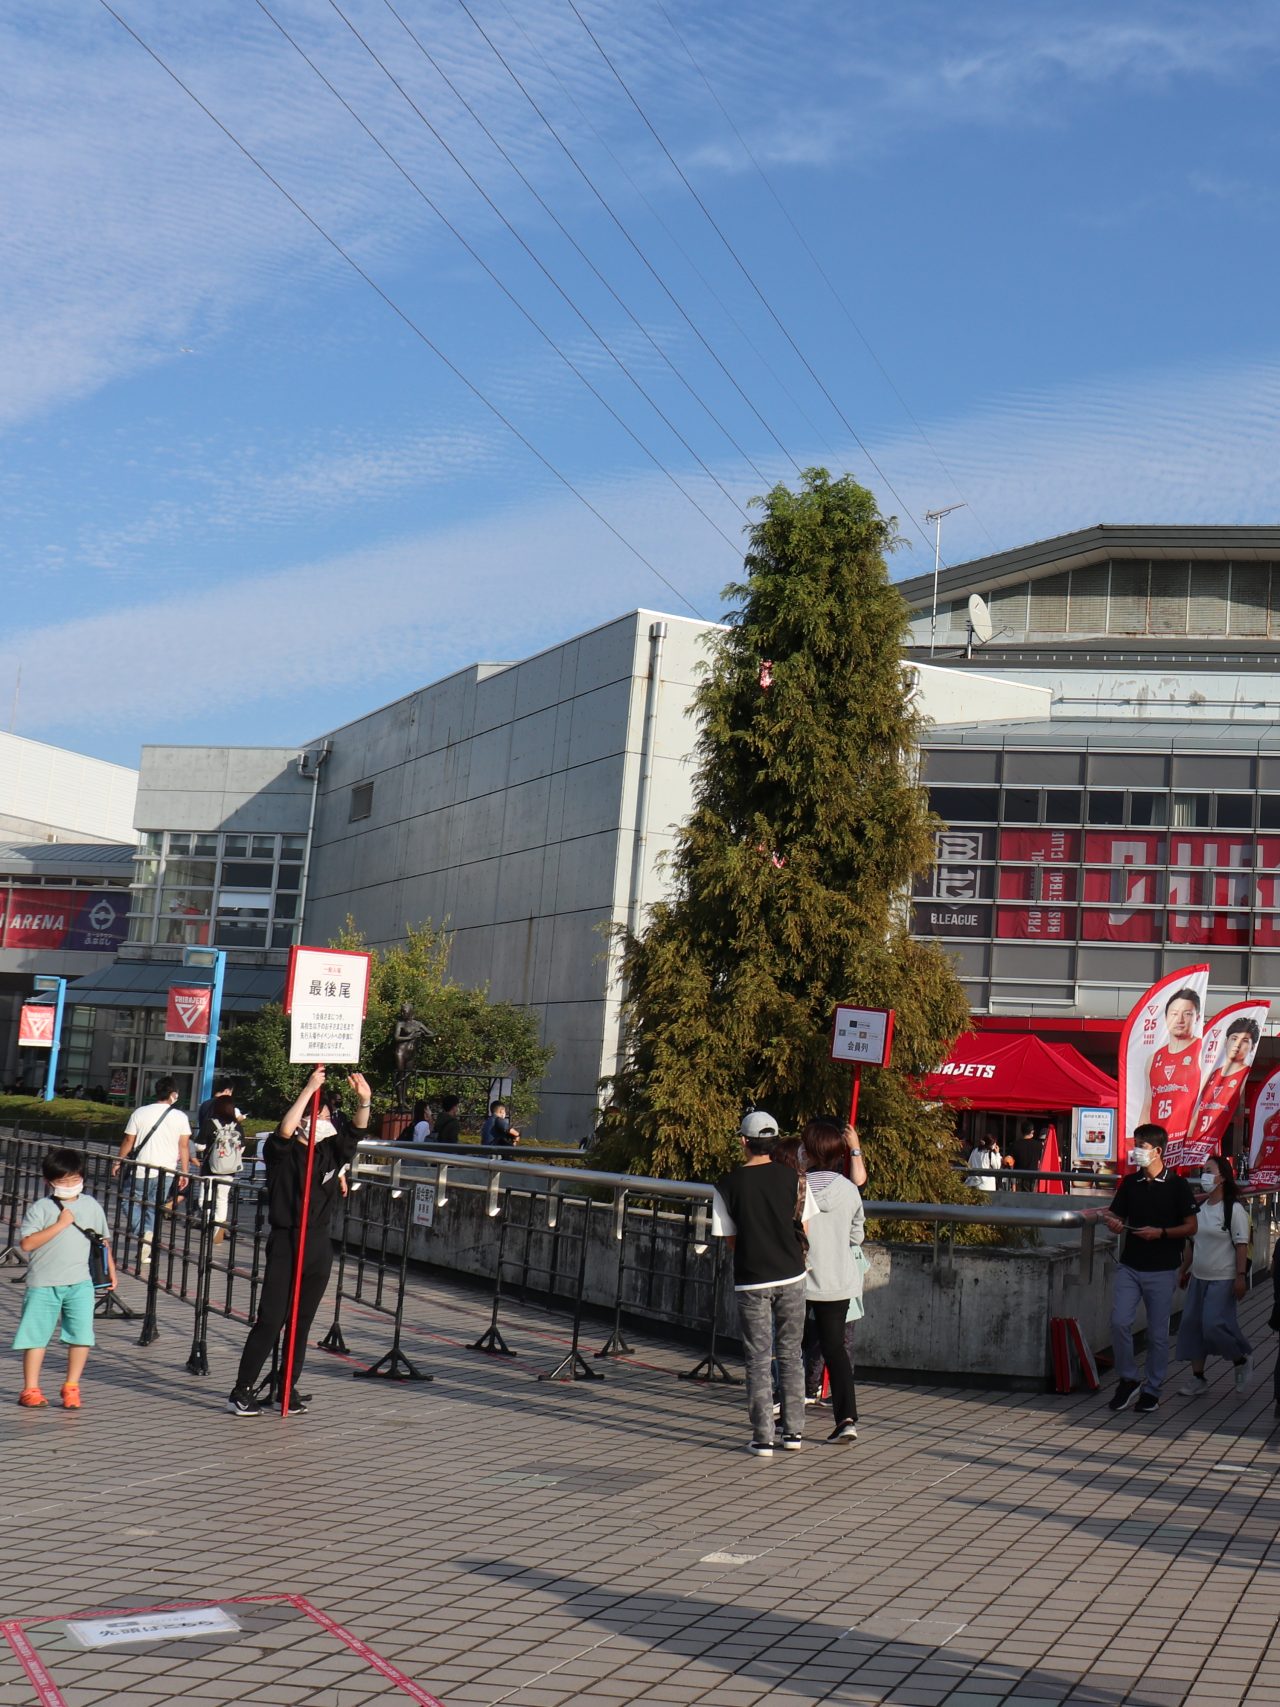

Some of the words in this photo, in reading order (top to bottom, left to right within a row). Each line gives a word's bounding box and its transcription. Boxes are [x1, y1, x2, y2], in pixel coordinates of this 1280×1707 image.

[10, 913, 65, 930] ARENA
[930, 912, 978, 926] B.LEAGUE
[309, 979, 351, 999] 最後尾
[1143, 1018, 1158, 1032] 25
[847, 1041, 869, 1053] 会員列
[1207, 1041, 1218, 1052] 31
[921, 1062, 996, 1079] BAJETS
[1265, 1092, 1276, 1101] 34
[1158, 1099, 1172, 1119] 25
[1200, 1115, 1213, 1132] 31
